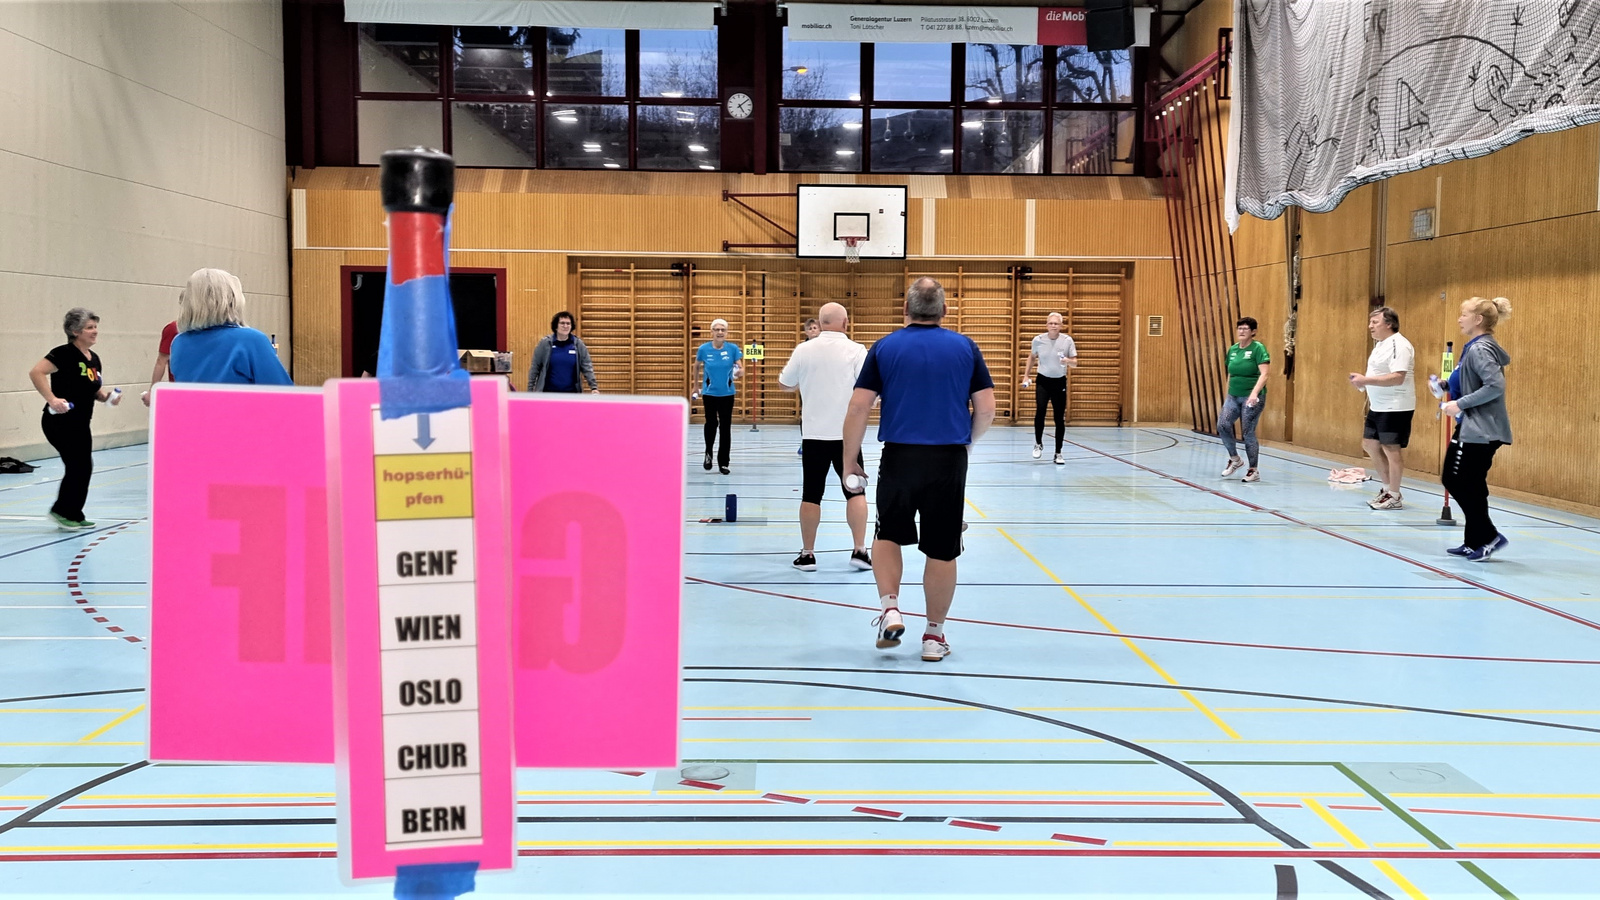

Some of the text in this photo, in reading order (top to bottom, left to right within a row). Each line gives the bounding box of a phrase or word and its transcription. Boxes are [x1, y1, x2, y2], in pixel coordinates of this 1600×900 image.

[850, 15, 892, 23] Generalagentur
[746, 348, 762, 356] BERN
[383, 467, 470, 484] hopserhü-
[405, 492, 444, 508] pfen
[396, 550, 458, 578] GENF
[395, 614, 462, 642] WIEN
[399, 678, 463, 707] OSLO
[397, 742, 467, 771] CHUR
[402, 805, 466, 834] BERN
